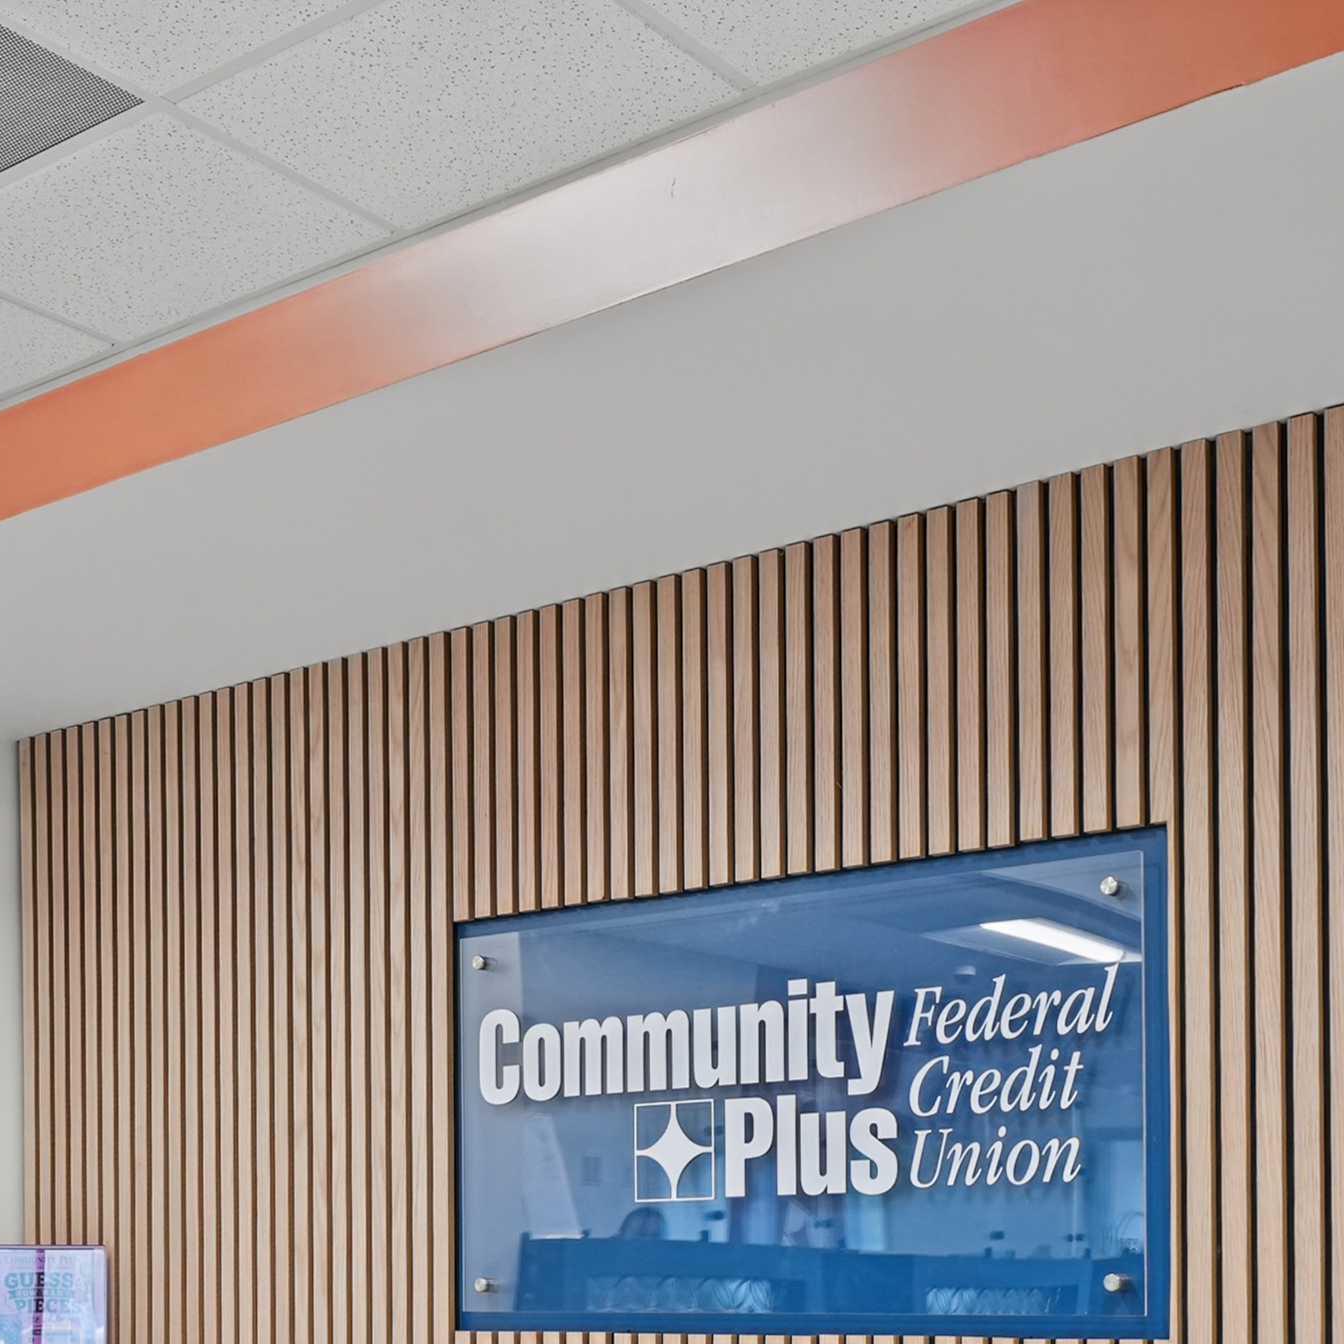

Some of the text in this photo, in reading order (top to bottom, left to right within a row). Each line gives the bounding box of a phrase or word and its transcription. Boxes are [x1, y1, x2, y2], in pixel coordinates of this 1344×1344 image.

[903, 963, 1120, 1047] Federal
[479, 978, 895, 1106] Community
[909, 1045, 1083, 1117] Credit
[724, 1094, 899, 1198] Plus
[909, 1128, 1082, 1189] Union
[4, 1272, 74, 1289] GUESS
[15, 1298, 83, 1313] PIECES
